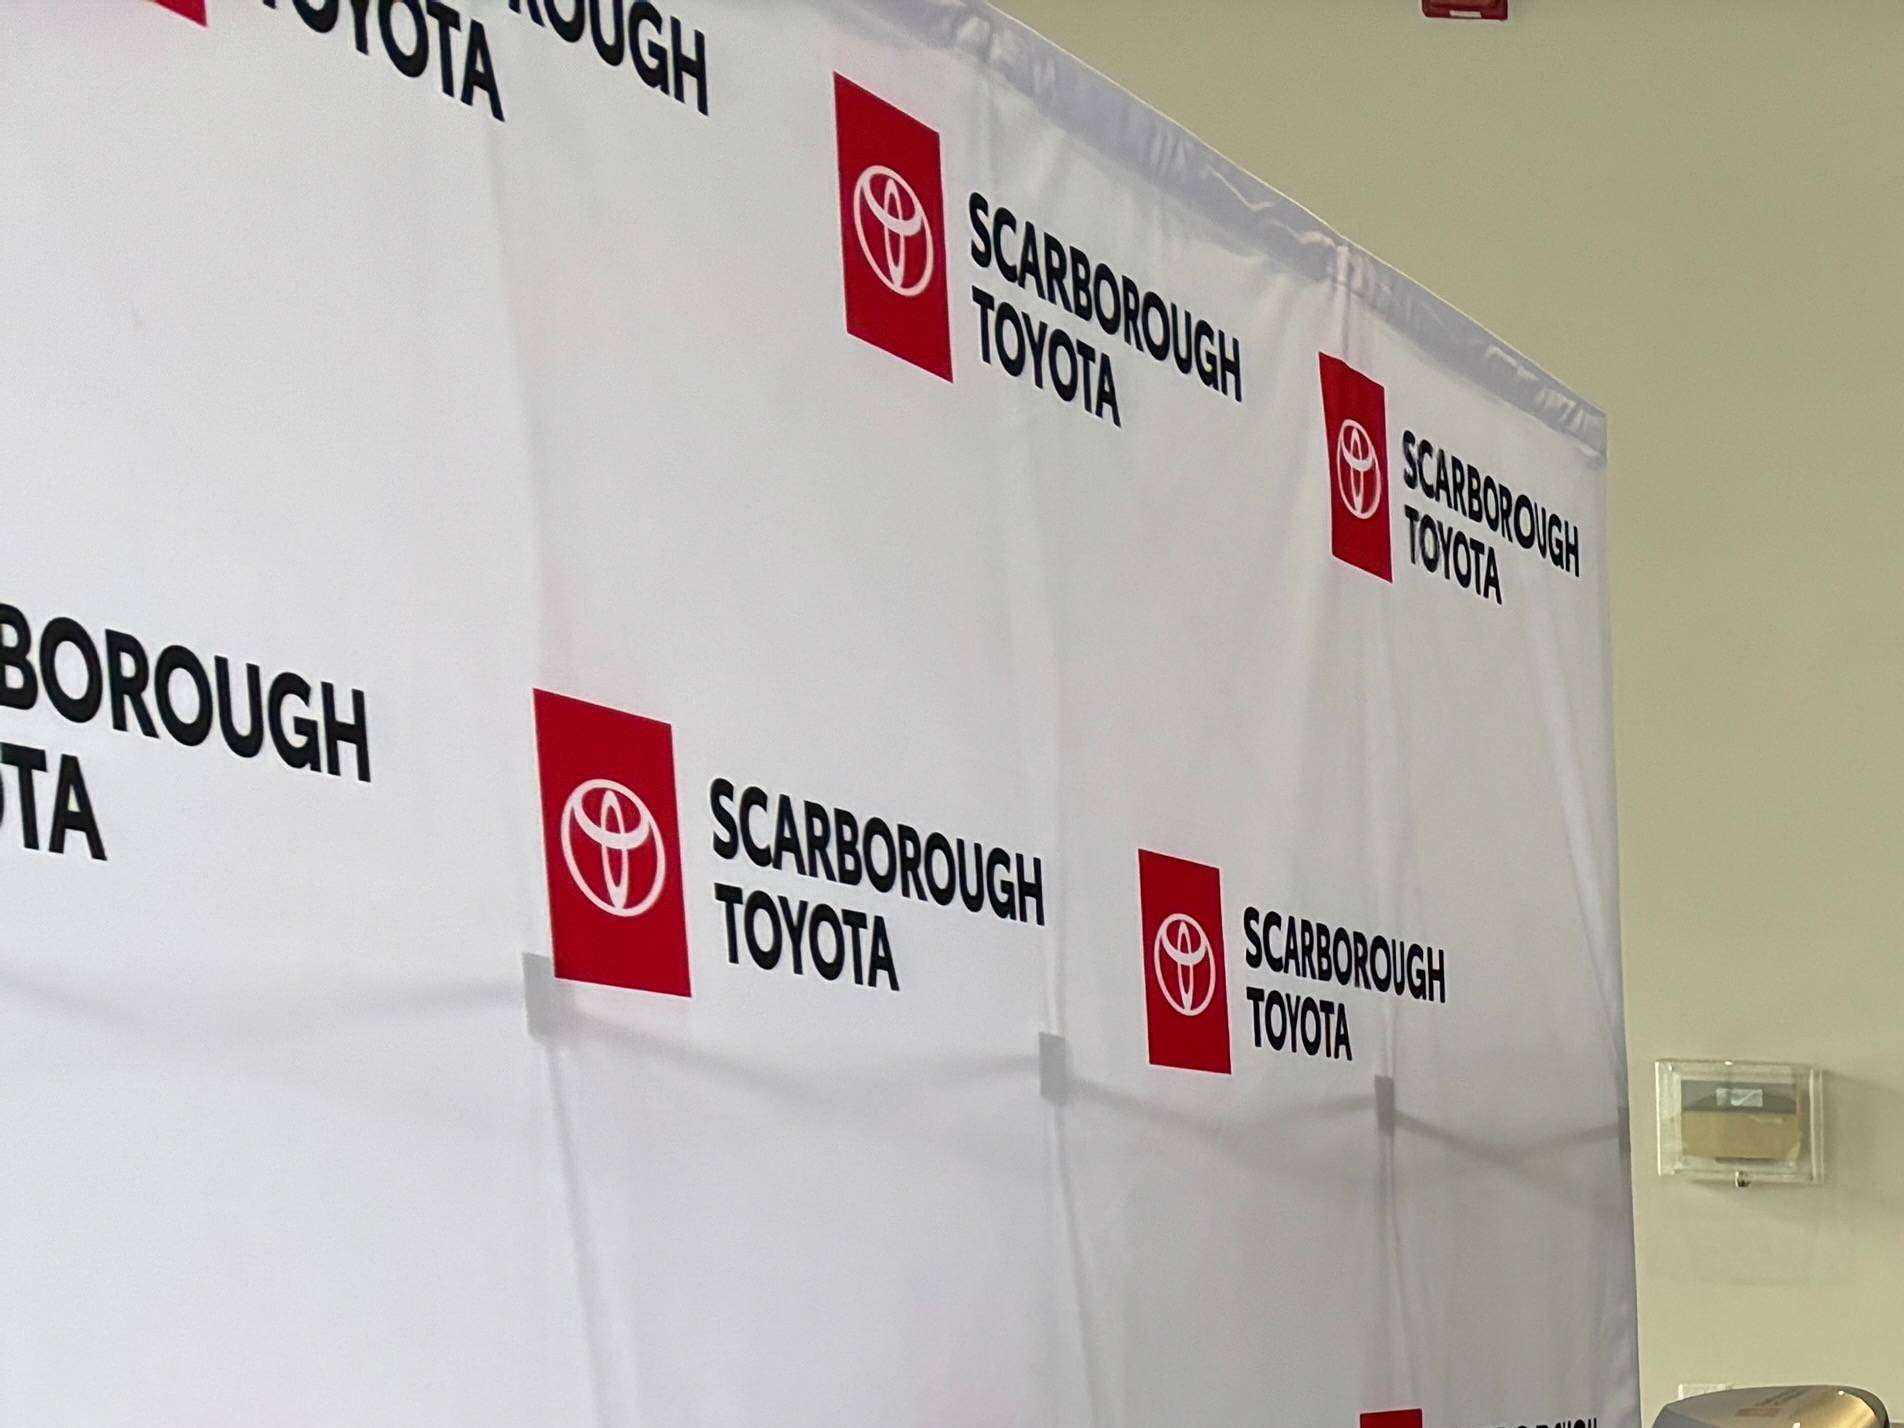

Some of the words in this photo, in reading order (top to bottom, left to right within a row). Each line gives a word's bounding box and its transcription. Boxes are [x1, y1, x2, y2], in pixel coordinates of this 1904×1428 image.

[968, 191, 1243, 404] SCARBOROUGH
[972, 285, 1122, 428] TOYOTA
[1401, 430, 1582, 579] SCARBOROUGH
[1403, 504, 1503, 605] TOYOTA
[0, 741, 108, 861] TA
[709, 776, 1046, 928] SCARBOROUGH
[713, 882, 901, 992] TOYOTA
[1244, 906, 1447, 1003] SCARBOROUGH
[1246, 986, 1353, 1061] TOYOTA
